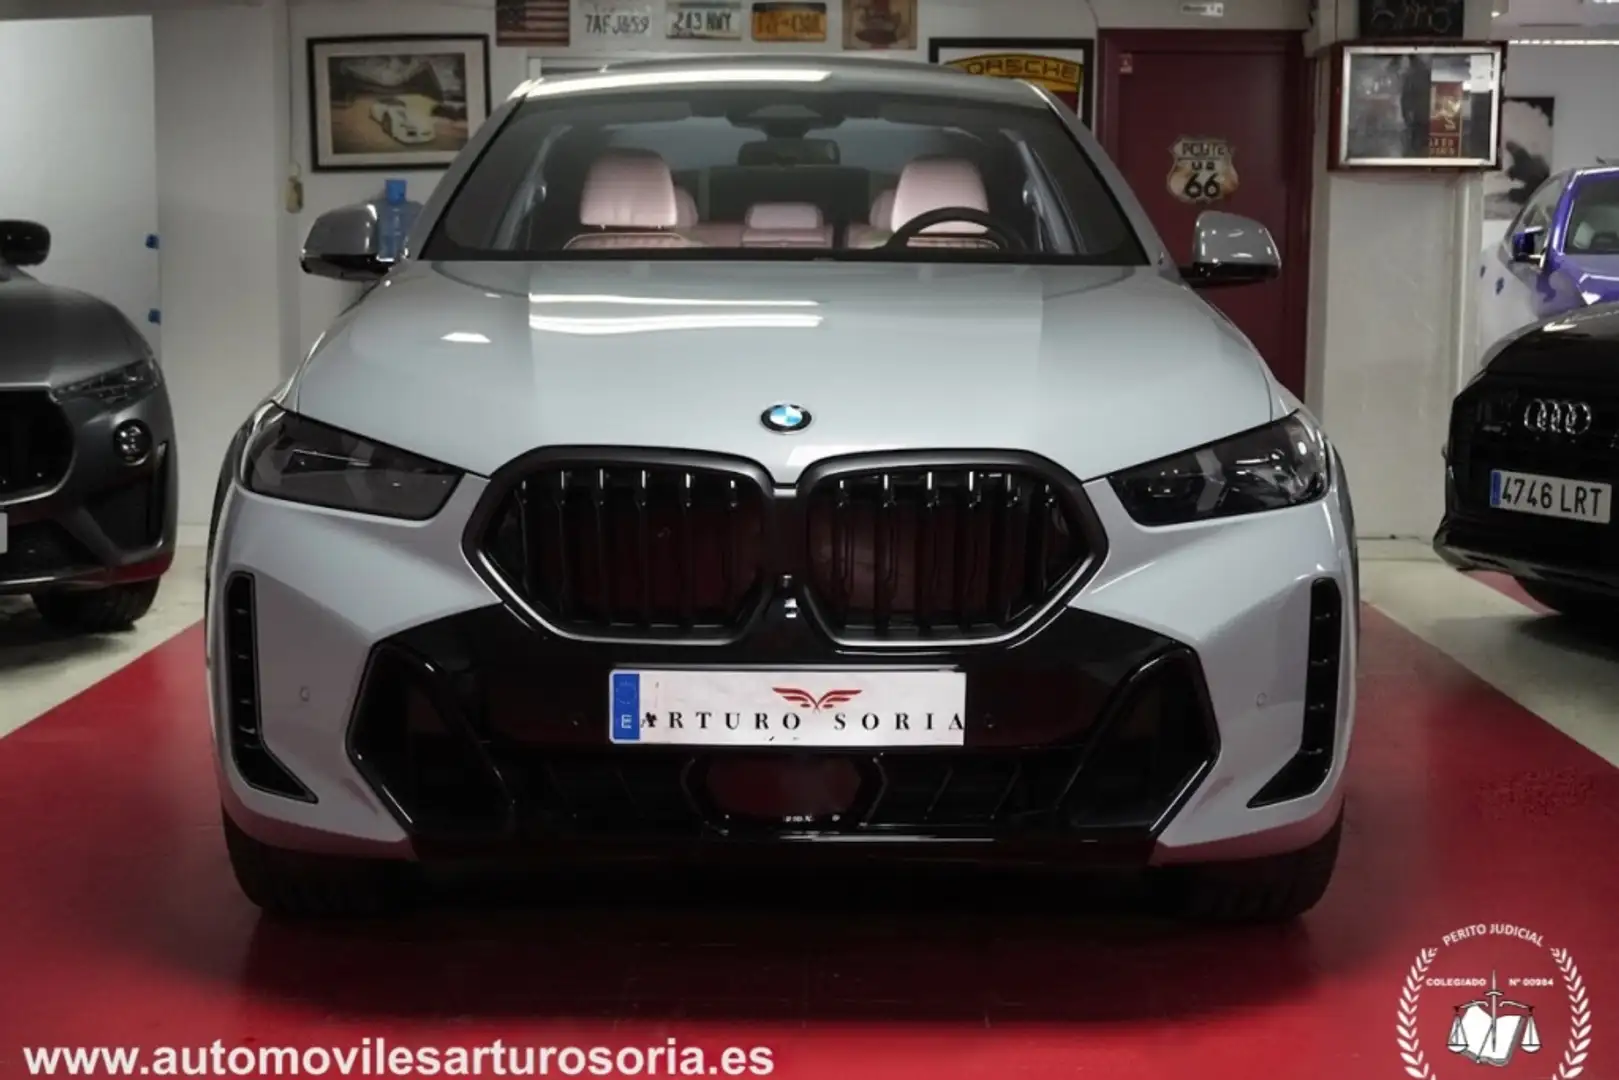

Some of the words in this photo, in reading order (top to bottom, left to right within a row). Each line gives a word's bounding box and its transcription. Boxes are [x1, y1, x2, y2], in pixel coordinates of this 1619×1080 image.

[966, 58, 1078, 80] ORSCHE
[1184, 172, 1220, 198] 66
[1502, 476, 1554, 509] 4746
[1560, 483, 1603, 517] LRT
[620, 714, 633, 729] E
[641, 711, 801, 731] ARTURO
[833, 712, 965, 731] SORIA
